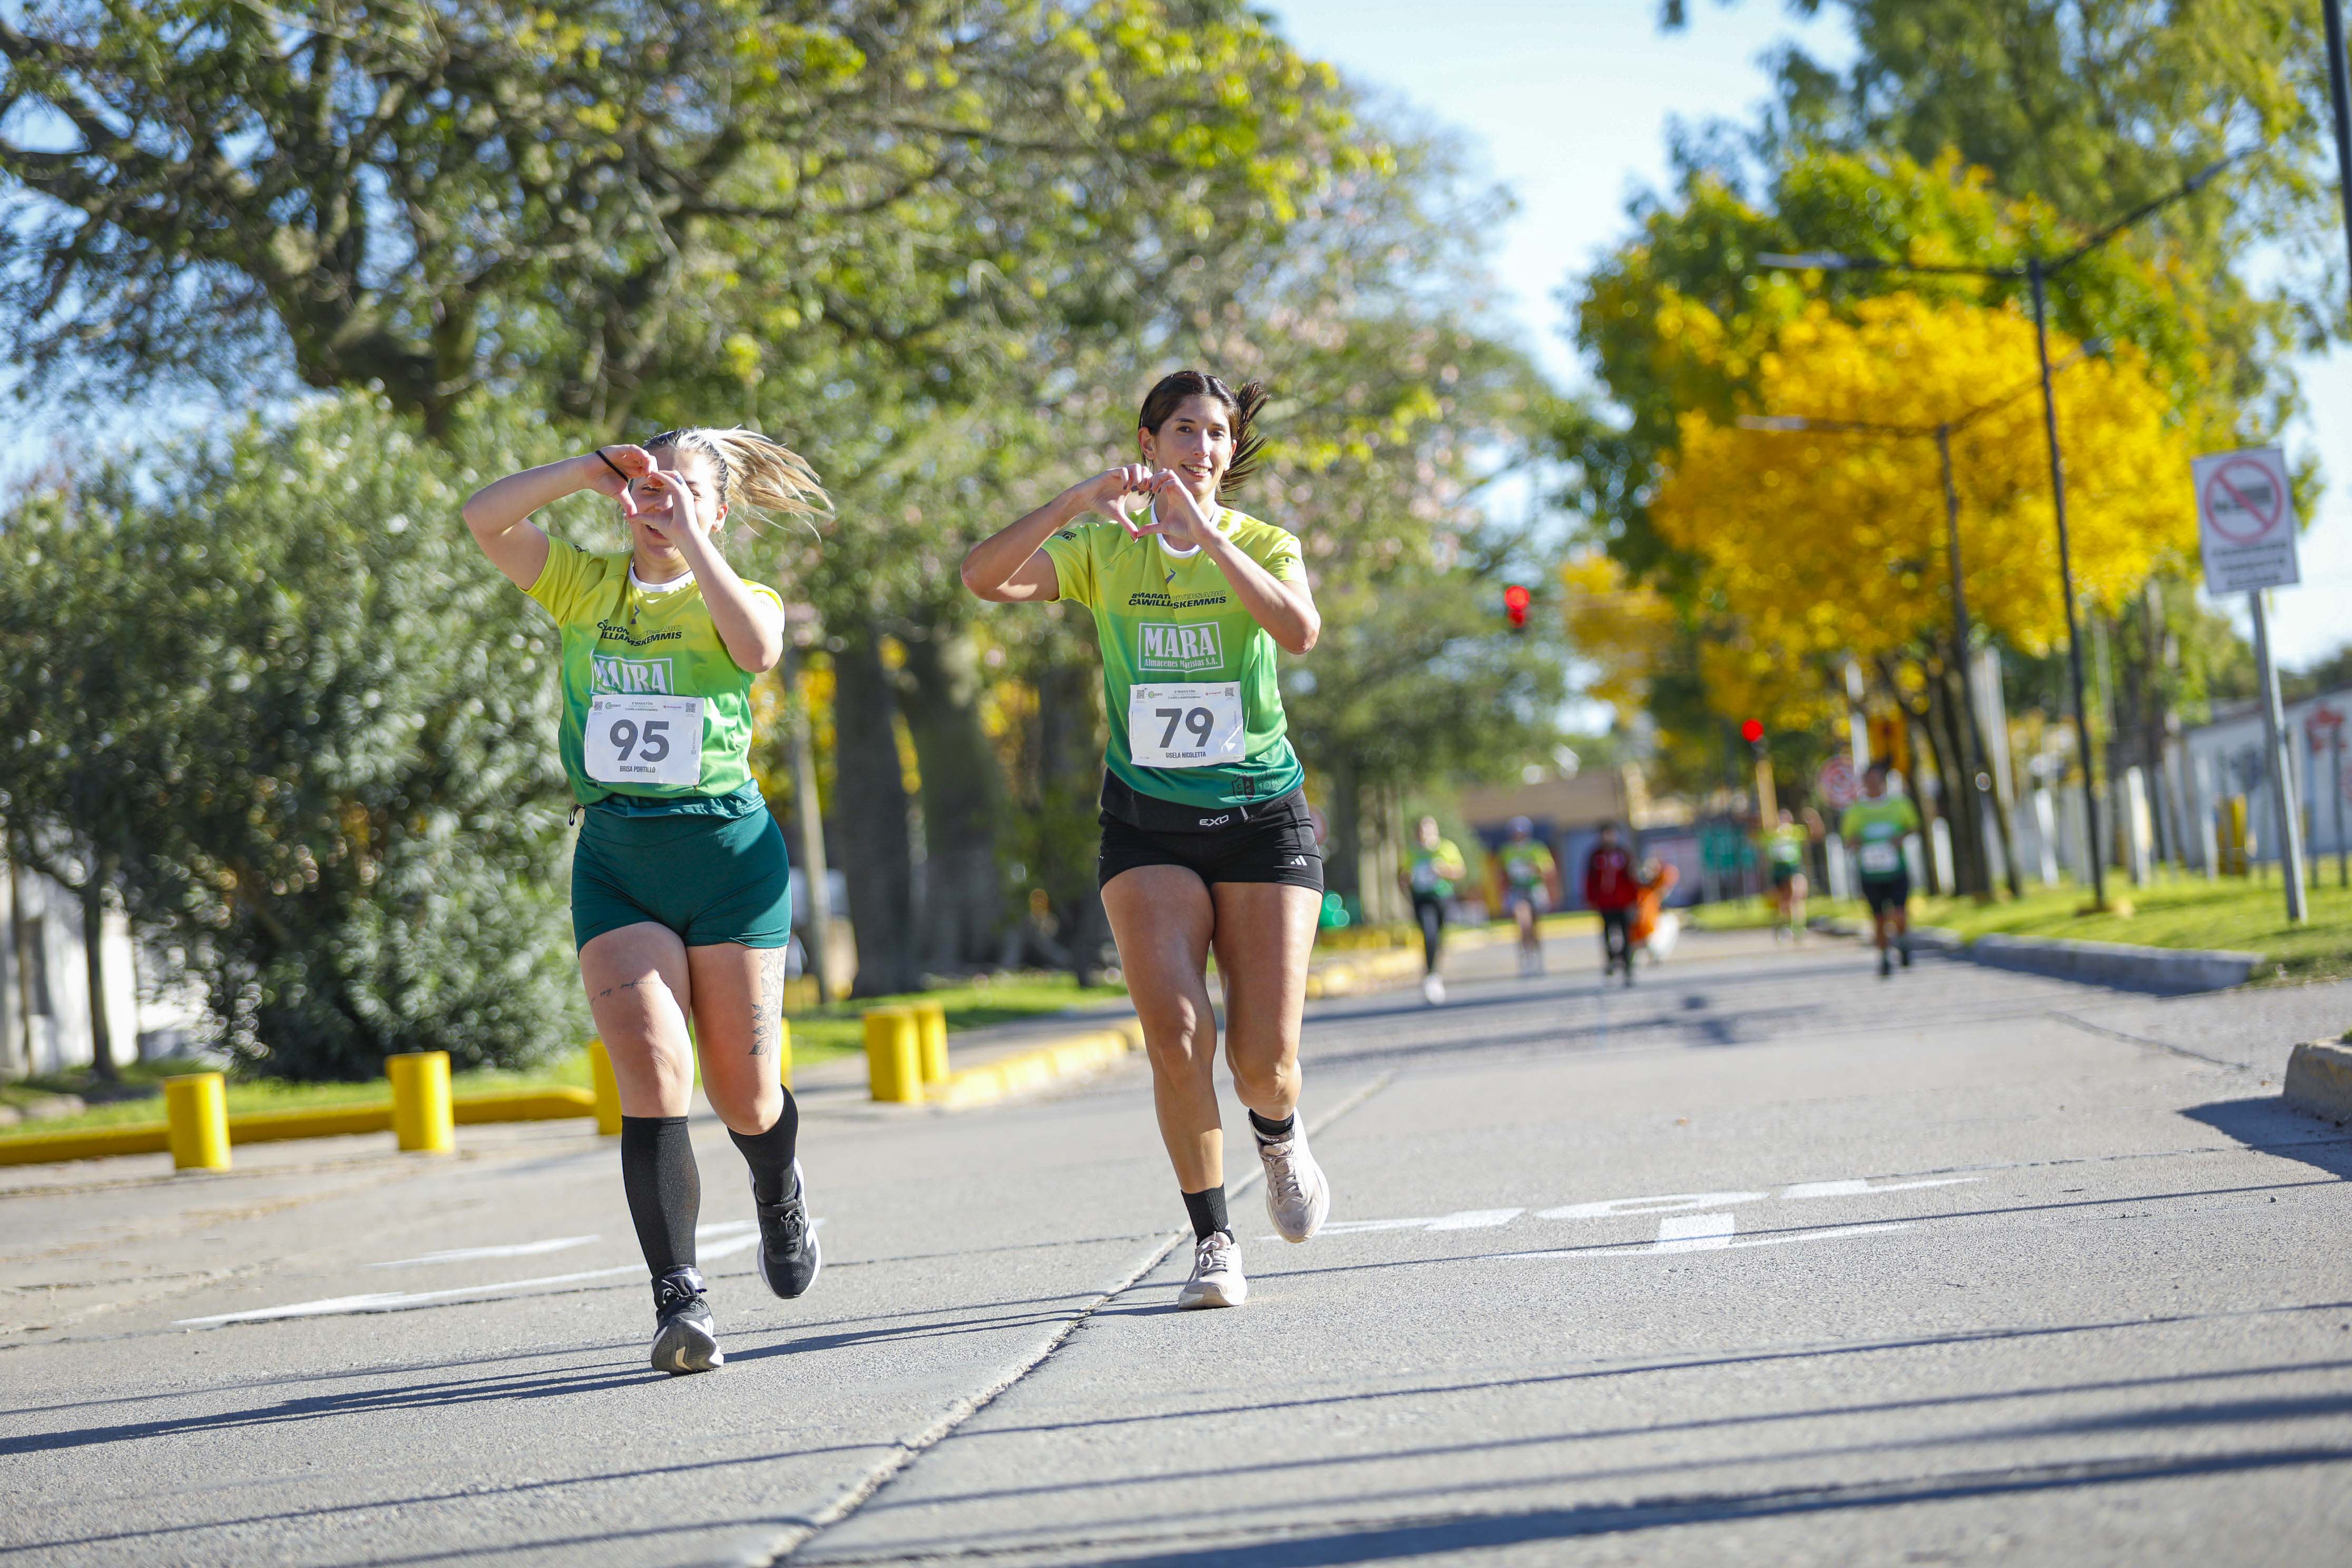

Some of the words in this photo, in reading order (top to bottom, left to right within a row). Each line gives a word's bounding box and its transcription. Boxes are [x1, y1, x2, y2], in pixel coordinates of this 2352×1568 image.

[1144, 628, 1216, 659] MARA
[1144, 659, 1178, 667] Almacenes
[610, 719, 670, 762] 95
[1155, 707, 1214, 748] 79
